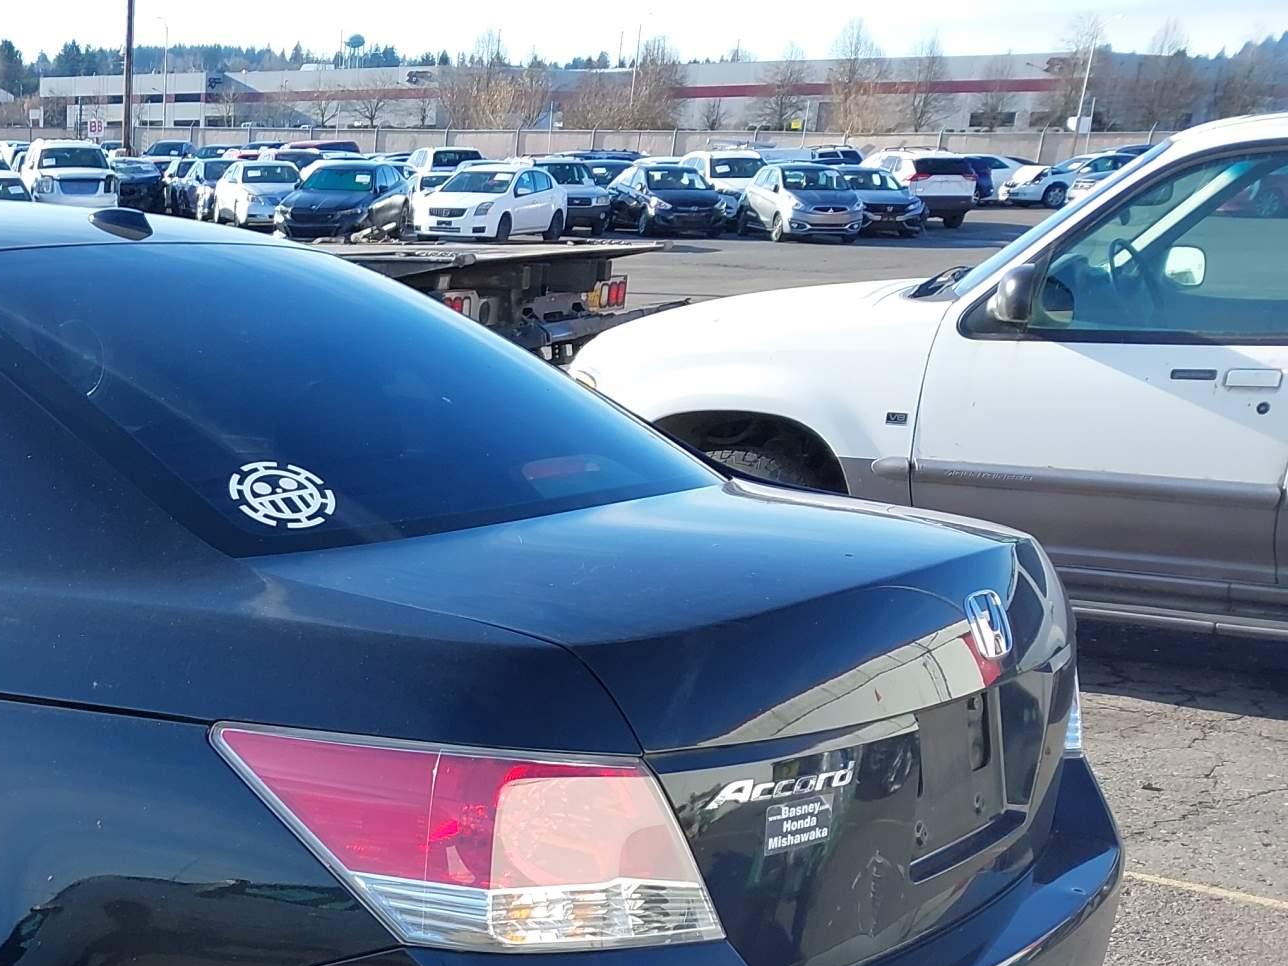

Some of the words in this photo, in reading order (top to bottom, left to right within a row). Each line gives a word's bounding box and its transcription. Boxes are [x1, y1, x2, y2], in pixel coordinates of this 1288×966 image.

[704, 760, 856, 810] Accord
[783, 815, 817, 833] Honda
[768, 827, 828, 850] Mishawaka
